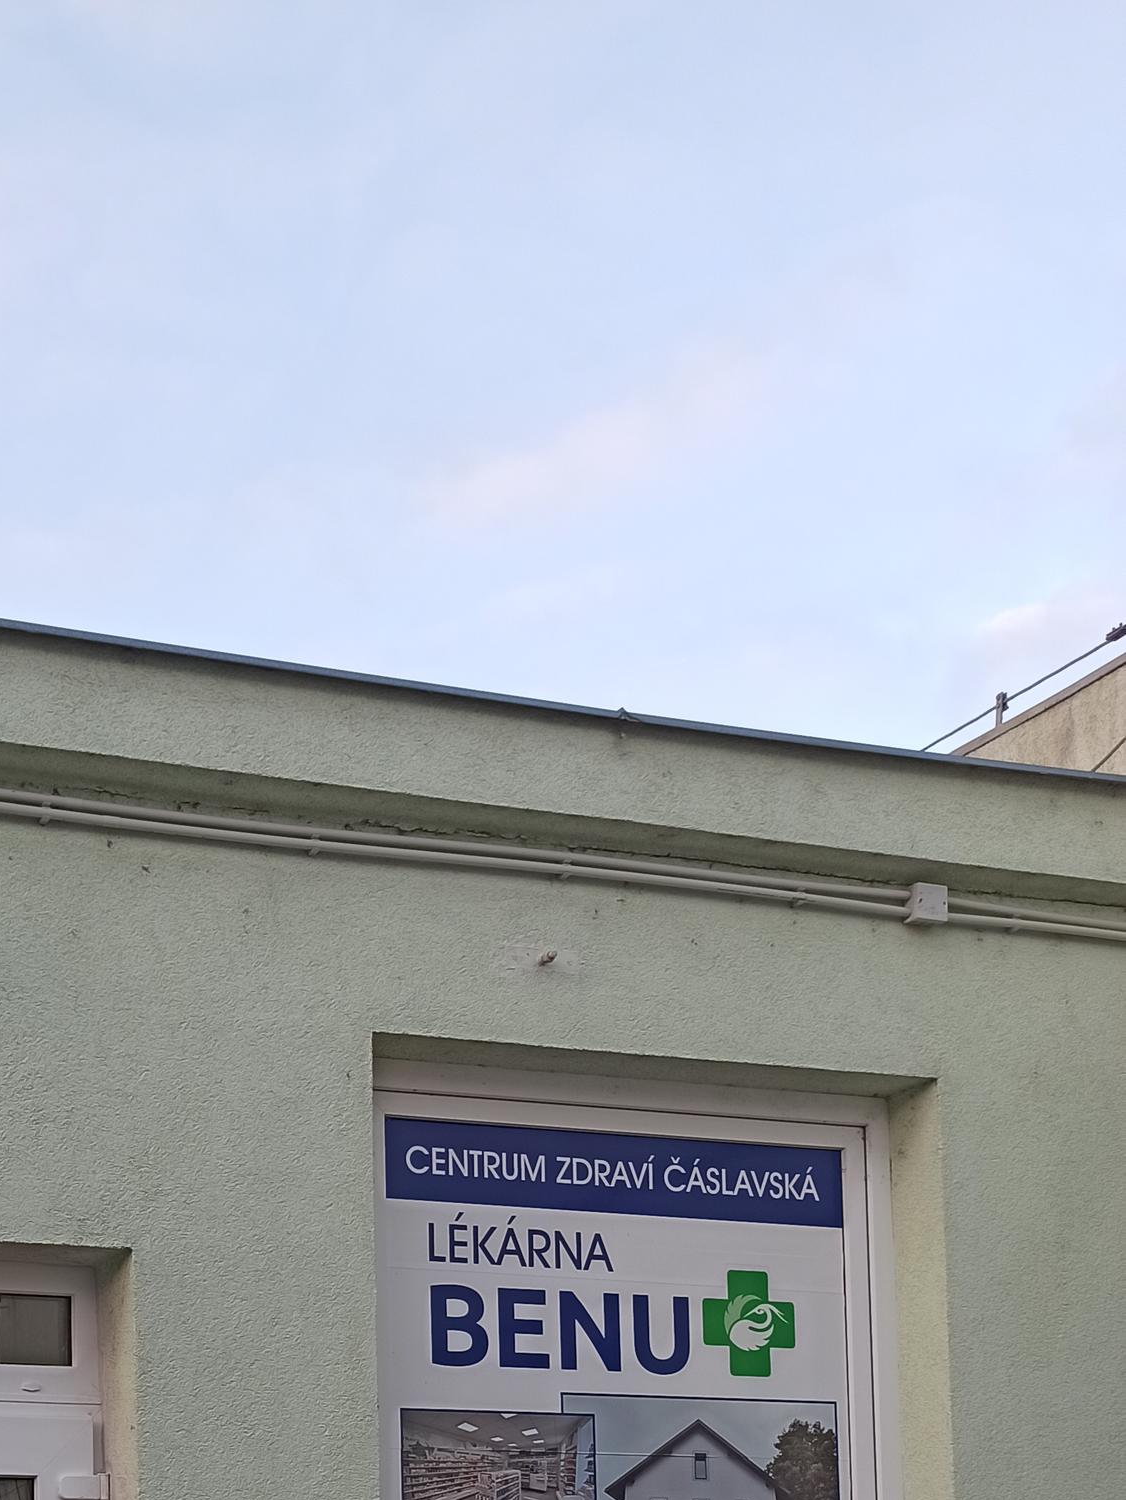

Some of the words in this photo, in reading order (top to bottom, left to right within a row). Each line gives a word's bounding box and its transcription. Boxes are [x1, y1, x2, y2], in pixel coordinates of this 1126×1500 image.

[406, 1146, 545, 1182] CENTRUM
[557, 1155, 654, 1189] ZDRAVÍ
[664, 1157, 819, 1201] ČÁSLAVSKÁ
[429, 1212, 613, 1272] LÉKÁRNA
[430, 1285, 690, 1375] BENU
